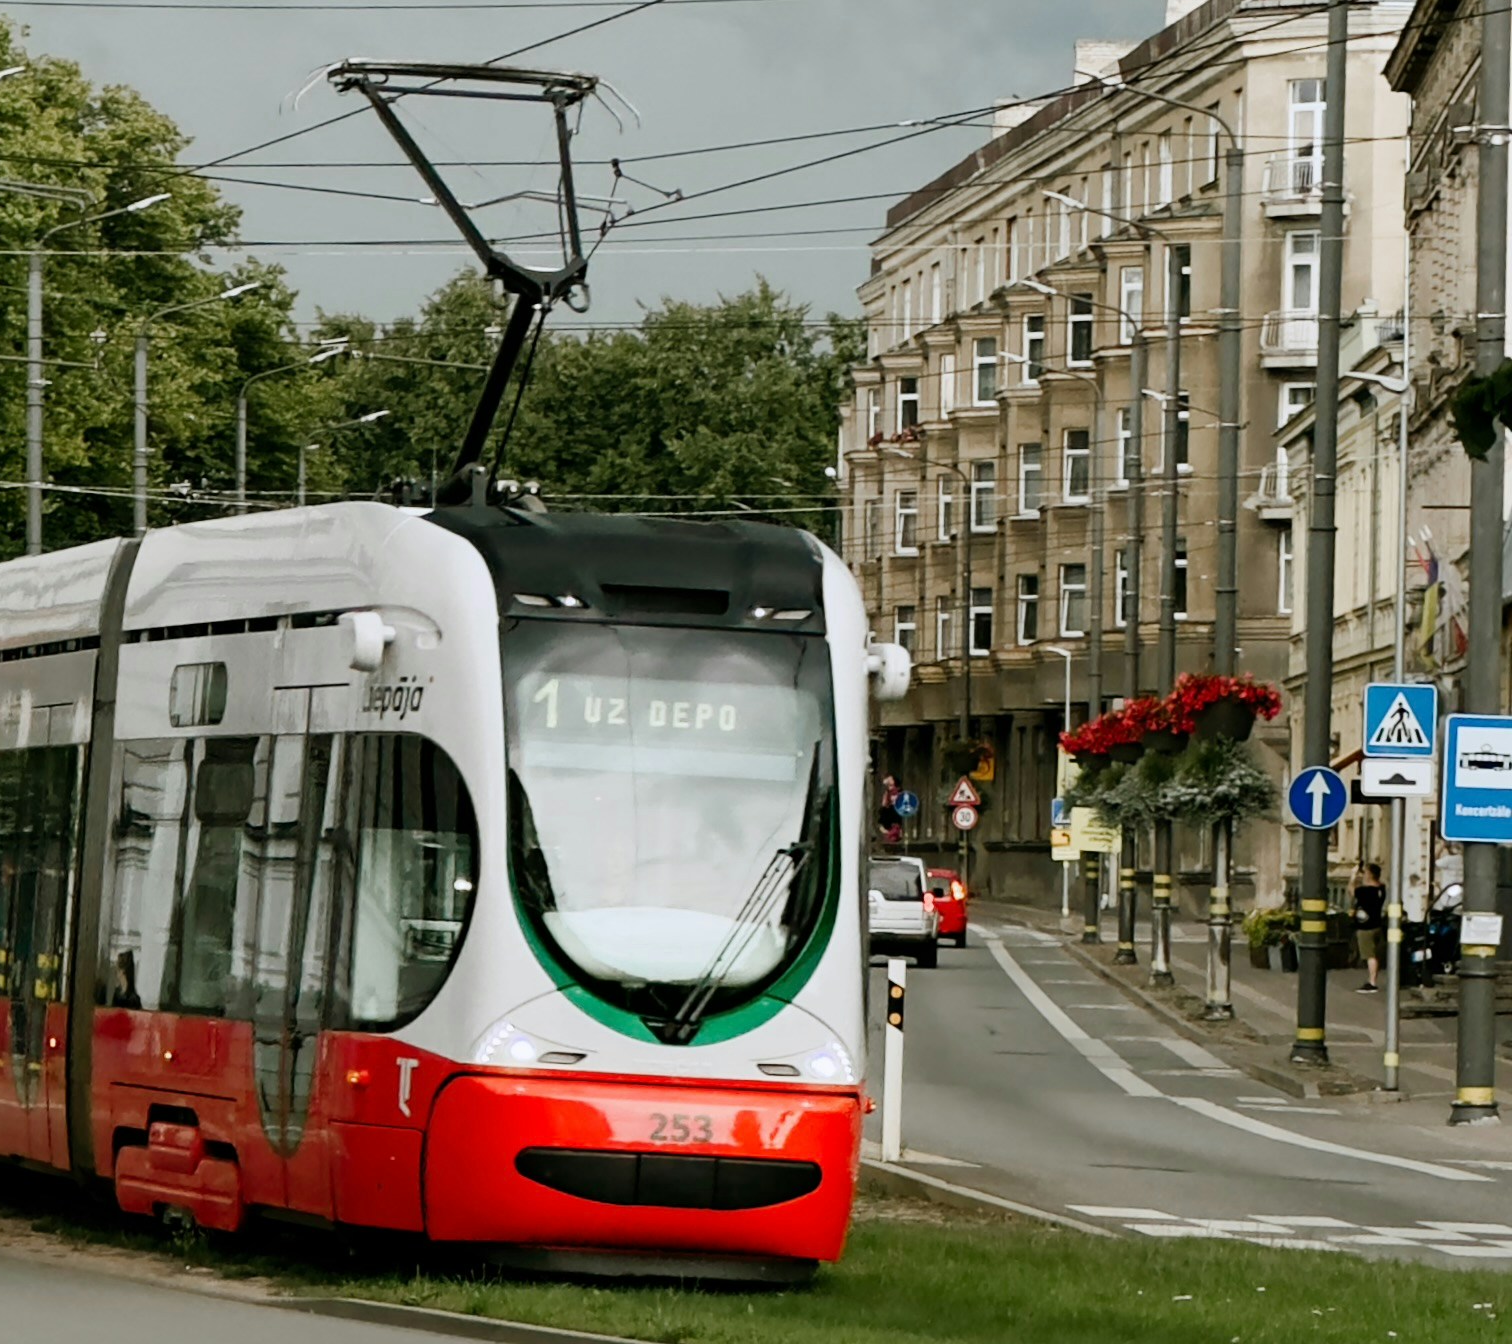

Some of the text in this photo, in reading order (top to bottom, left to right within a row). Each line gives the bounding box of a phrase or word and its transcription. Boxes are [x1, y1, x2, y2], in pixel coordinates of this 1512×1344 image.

[533, 678, 736, 732] 1 UZ DEPO
[959, 811, 972, 823] 30
[649, 1113, 714, 1143] 253
